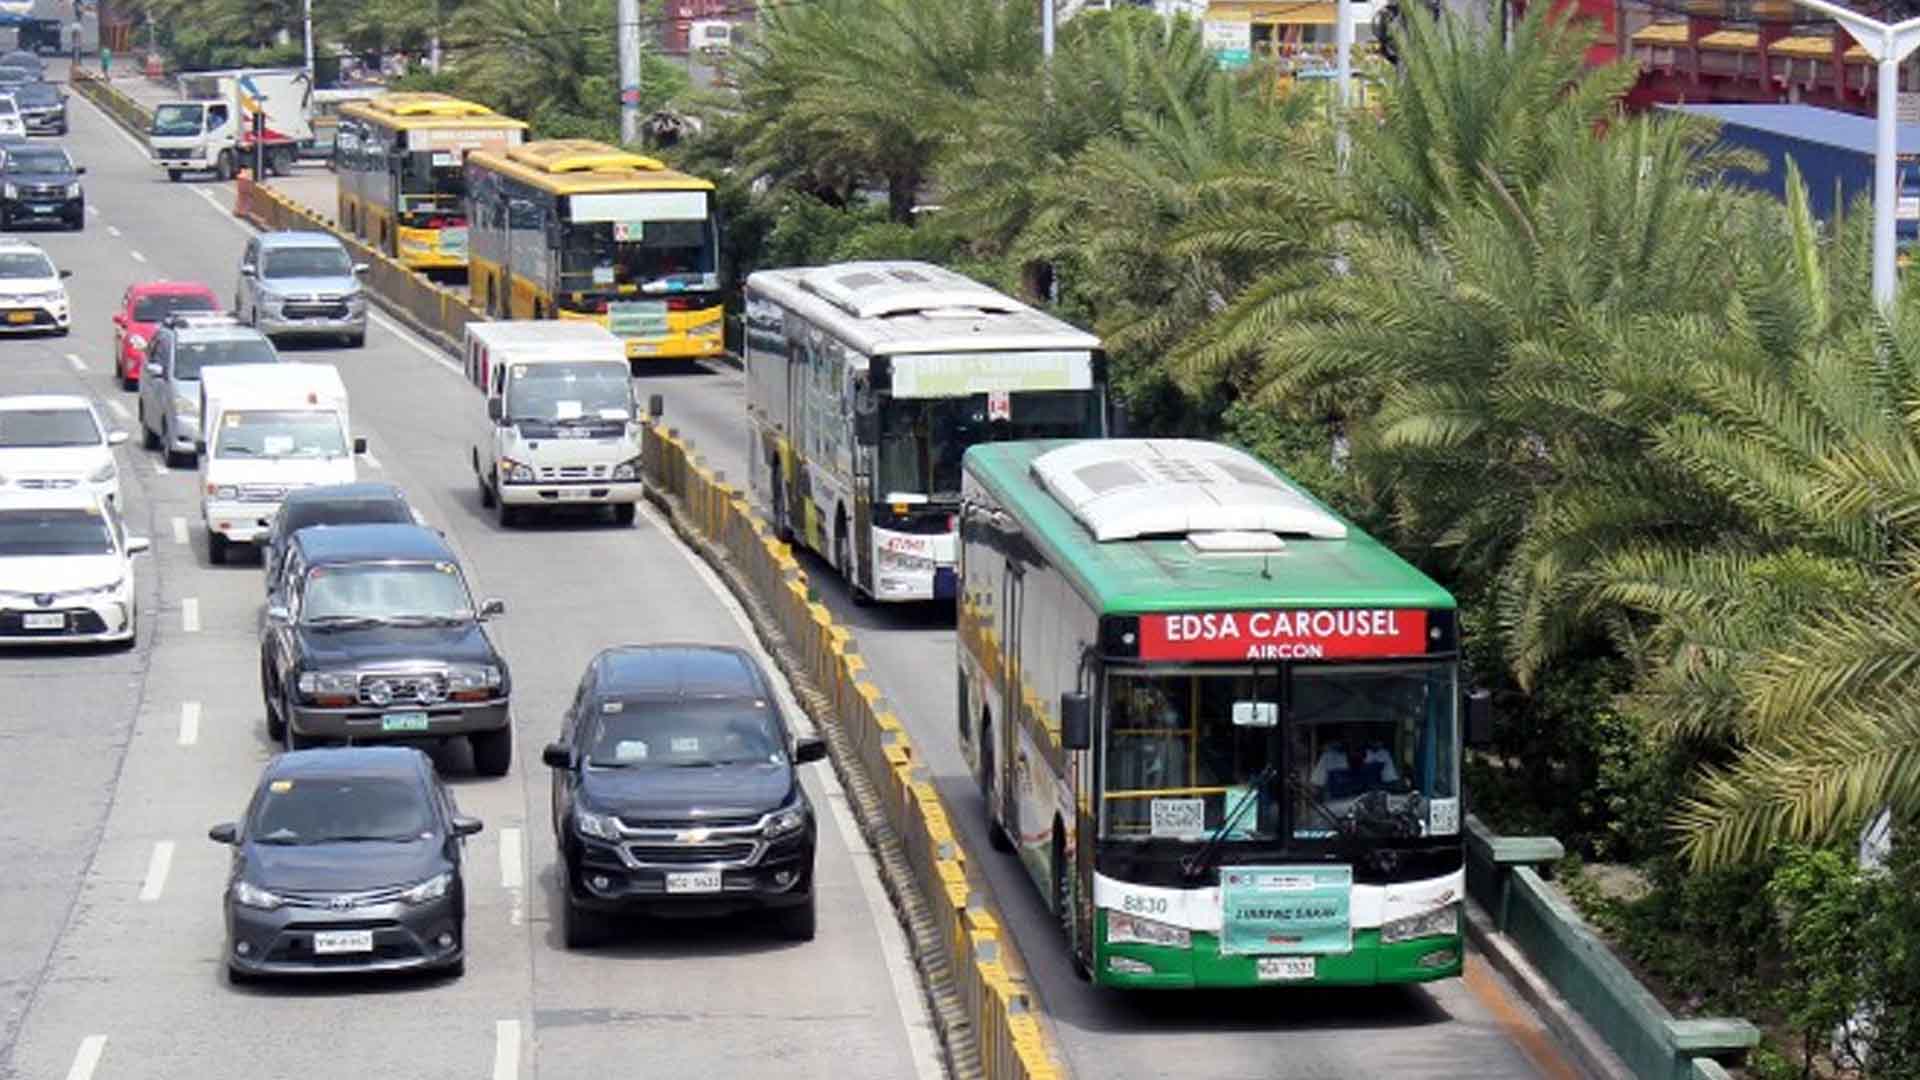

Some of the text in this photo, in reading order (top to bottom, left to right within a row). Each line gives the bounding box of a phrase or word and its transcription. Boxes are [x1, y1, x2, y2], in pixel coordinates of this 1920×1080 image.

[1165, 610, 1399, 641] EDSA CAROUSEL
[1246, 643, 1324, 659] AIRCON
[1123, 895, 1167, 914] 8830
